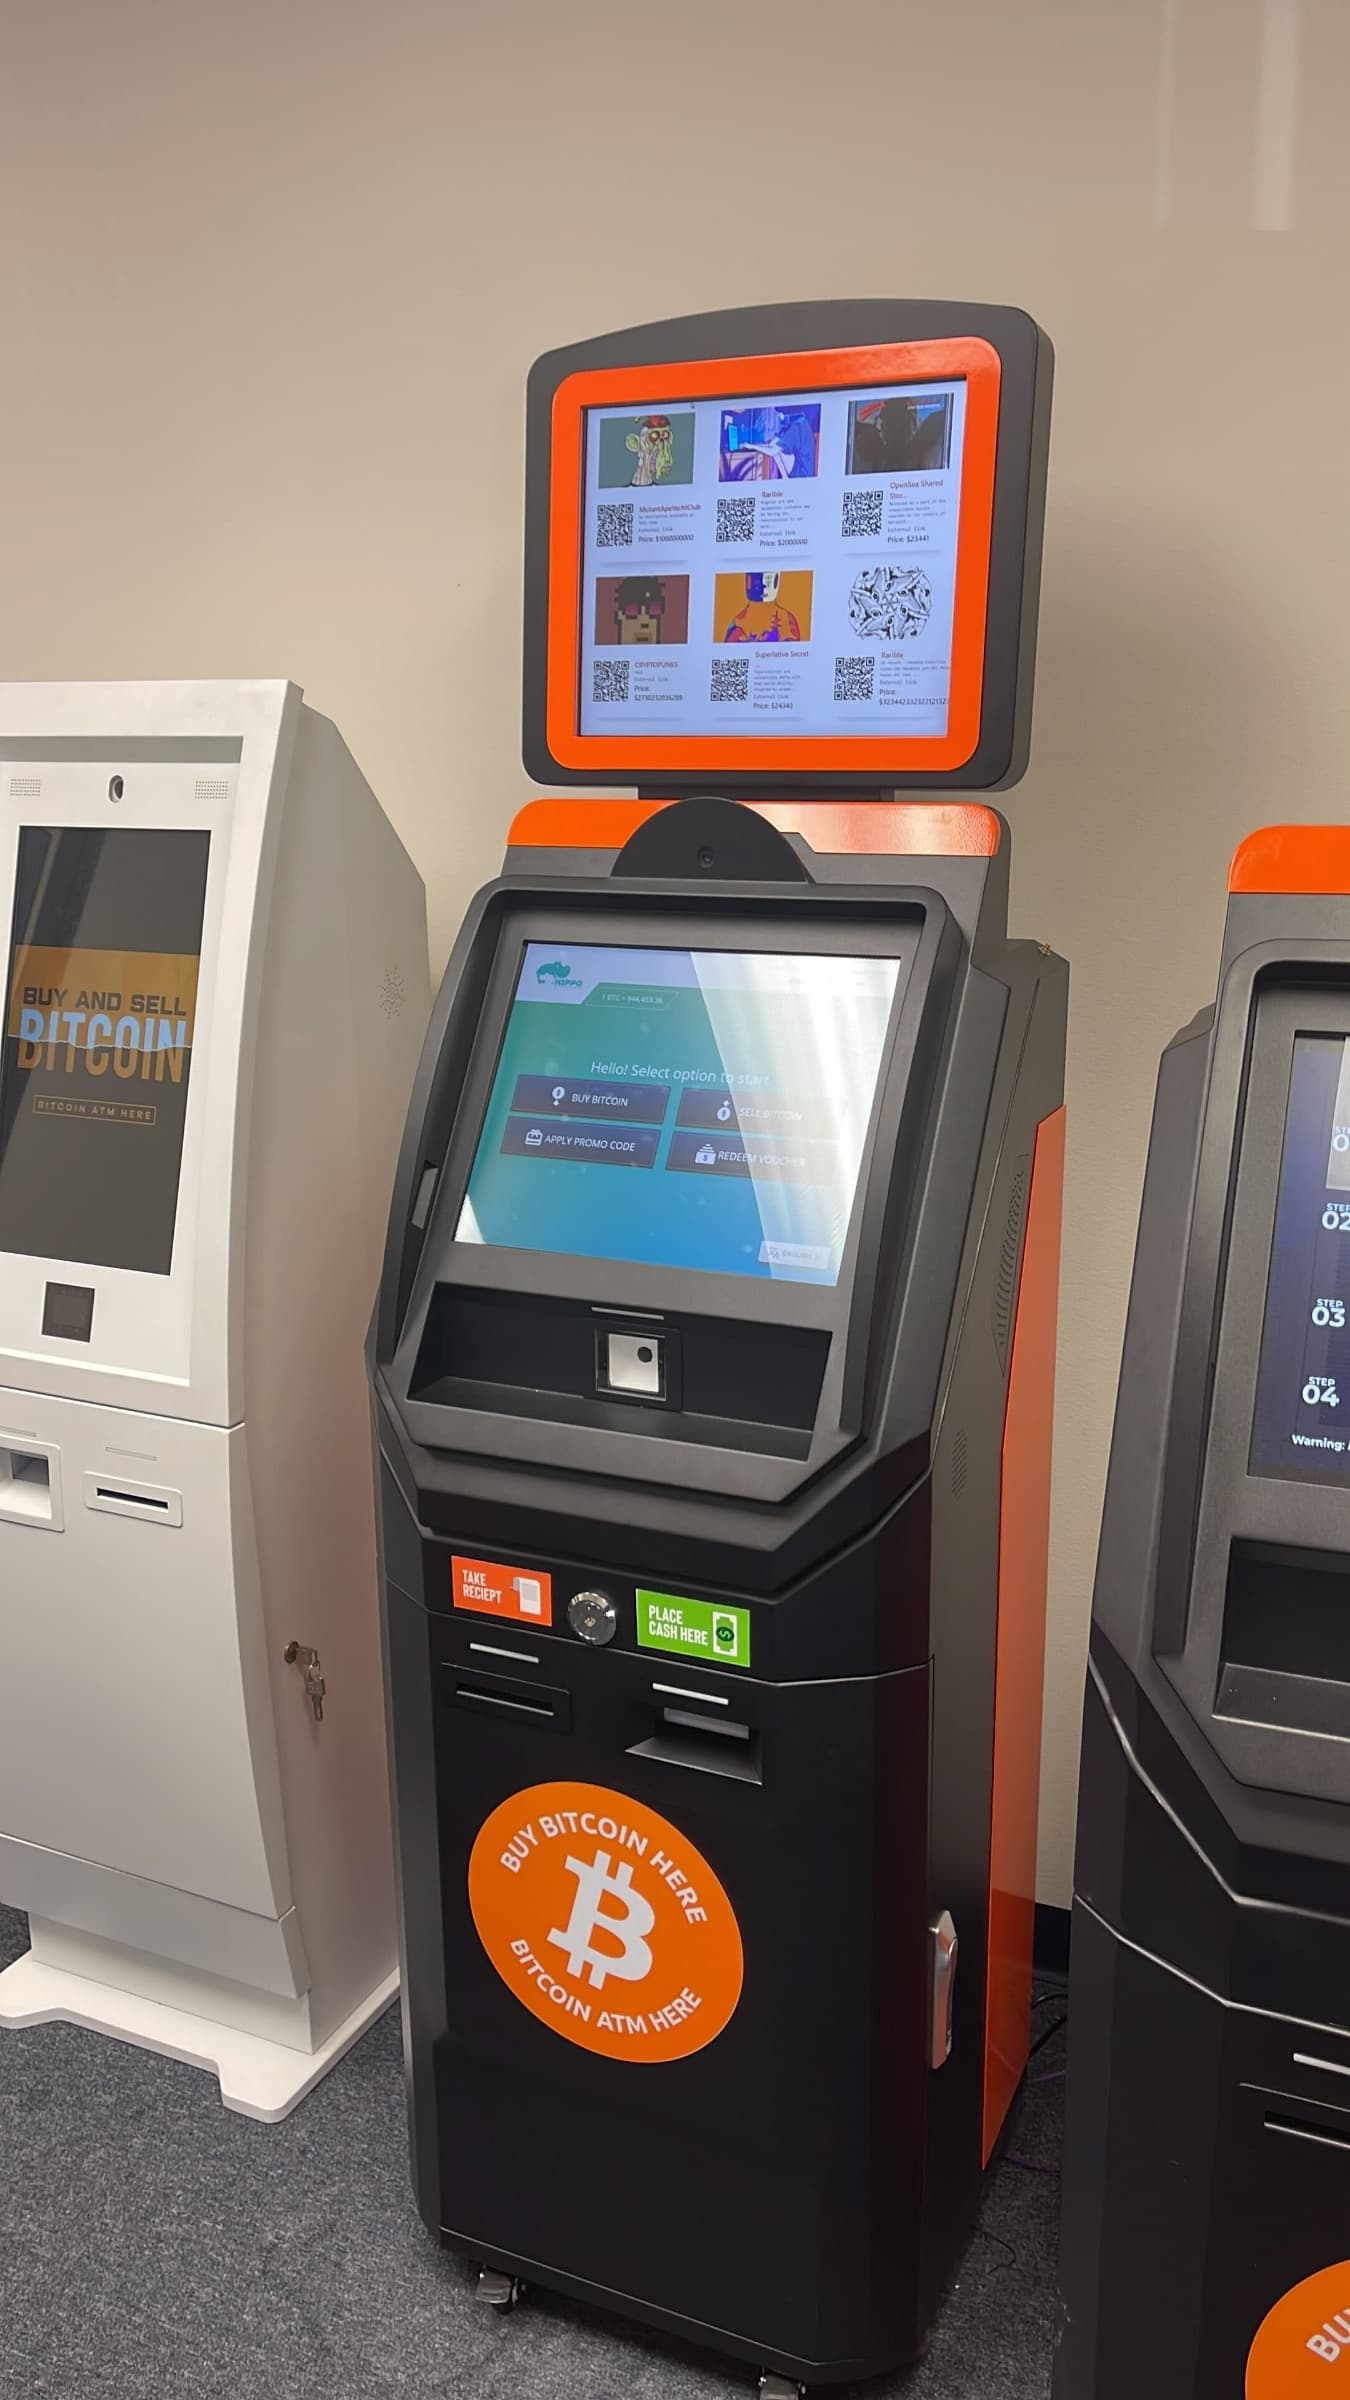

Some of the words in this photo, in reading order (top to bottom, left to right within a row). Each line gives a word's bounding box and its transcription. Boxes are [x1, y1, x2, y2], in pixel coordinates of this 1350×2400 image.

[890, 481, 919, 490] OpenSea
[921, 480, 944, 488] Shared
[887, 535, 904, 543] Price:
[23, 986, 68, 1007] BUY
[76, 990, 122, 1011] AND
[130, 994, 187, 1017] SELL
[17, 1008, 187, 1083] BITCOIN
[591, 1061, 628, 1076] Hello!
[631, 1064, 670, 1079] Select
[673, 1069, 716, 1084] option
[720, 1073, 734, 1084] to
[571, 1093, 590, 1104] BUY
[591, 1095, 629, 1107] BITCOIN
[37, 1100, 86, 1113] BITCOIN
[91, 1106, 116, 1116] ATM
[120, 1109, 152, 1121] HERE
[544, 1135, 571, 1146] APPLY
[573, 1138, 608, 1150] PROMO
[609, 1141, 636, 1152] CODE
[1333, 1134, 1350, 1152] 0
[718, 1151, 757, 1163] REDEEM
[1316, 1299, 1343, 1308] STEP
[1312, 1307, 1346, 1327] 03
[1308, 1377, 1336, 1387] STEP
[1302, 1385, 1340, 1407] 04
[1291, 1434, 1345, 1452] Warning:
[462, 1569, 486, 1586] TAKE
[462, 1584, 502, 1604] RECIEPT
[648, 1604, 683, 1625] PLACE
[648, 1620, 678, 1639] CASH
[680, 1627, 708, 1646] HERE
[500, 1824, 539, 1873] BUY
[538, 1811, 649, 1857] BITCOIN
[649, 1850, 708, 1924] HERE
[509, 1938, 591, 2022] BITCOIN
[596, 2011, 648, 2035] ATM
[648, 1986, 703, 2033] HERE
[1306, 2308, 1350, 2362] BU
